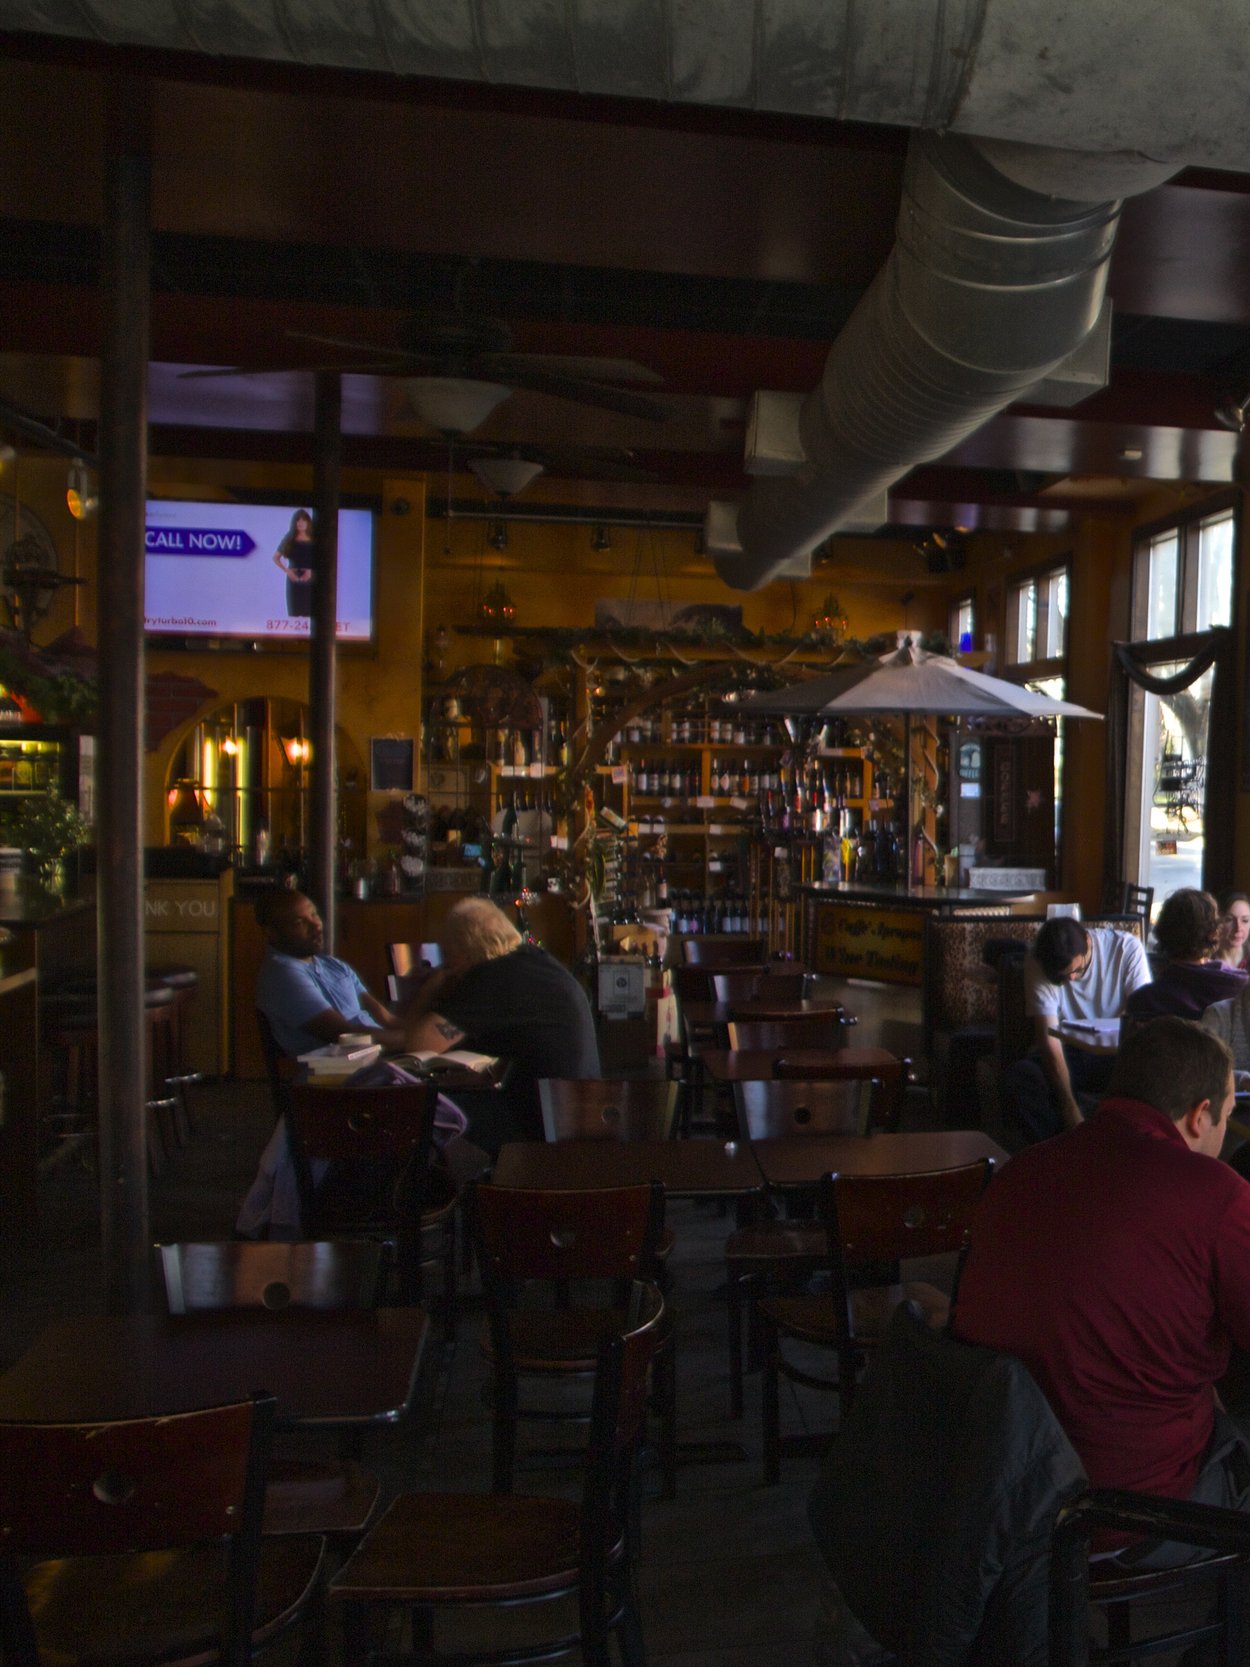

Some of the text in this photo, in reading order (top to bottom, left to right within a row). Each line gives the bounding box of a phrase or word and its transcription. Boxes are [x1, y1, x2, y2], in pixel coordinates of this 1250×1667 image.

[145, 531, 241, 550] CALL NOW!
[175, 901, 215, 917] YOU
